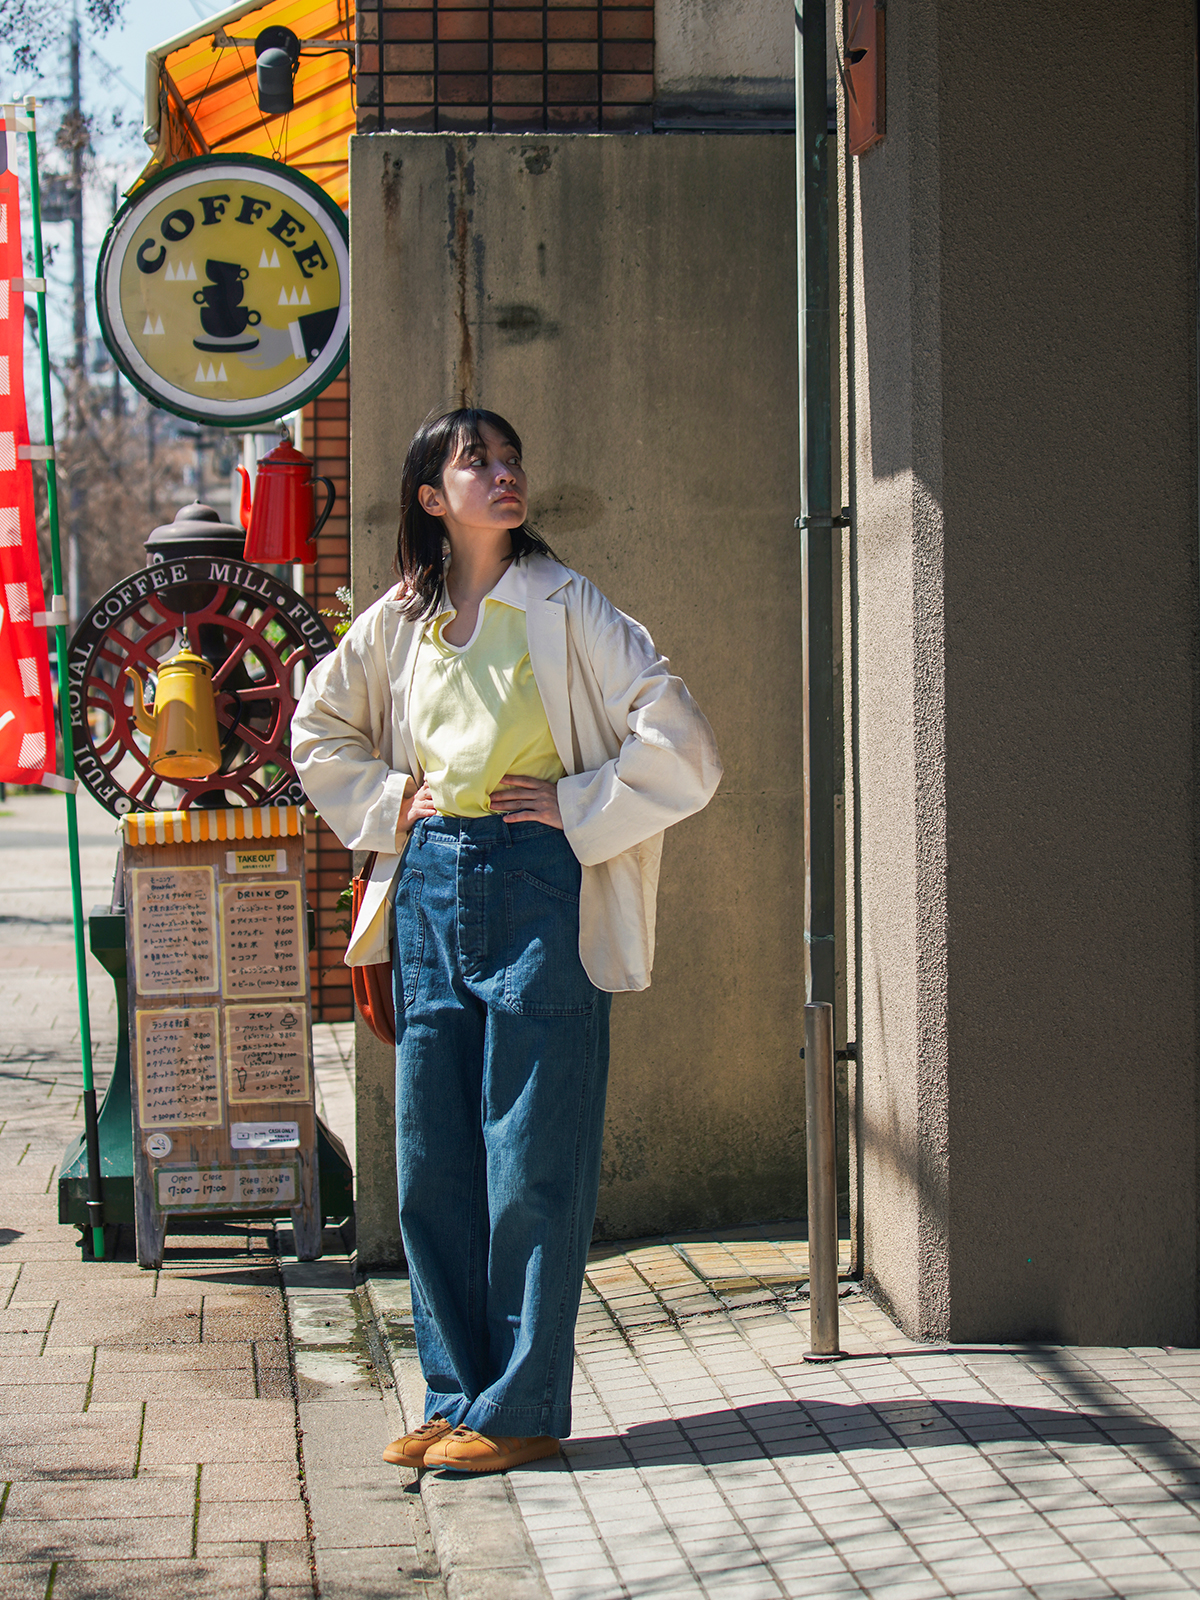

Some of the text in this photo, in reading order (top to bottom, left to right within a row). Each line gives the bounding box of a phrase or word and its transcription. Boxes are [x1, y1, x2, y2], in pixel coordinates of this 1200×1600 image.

[136, 194, 328, 278] COFFEE
[208, 563, 272, 598] MILL
[92, 564, 188, 629] COFFEE
[69, 642, 94, 726] ROYAL
[73, 744, 119, 802] FUJI
[237, 854, 275, 863] TAKE OUT
[237, 890, 271, 900] DRINK
[276, 904, 295, 912] ¥500
[276, 916, 294, 924] ¥500
[275, 928, 294, 936] ¥600
[274, 940, 293, 949] ¥550
[278, 965, 297, 973] ¥550
[248, 1012, 273, 1020] スイーツ
[171, 1173, 222, 1184] Open Close
[168, 1186, 192, 1197] 7:00
[203, 1185, 226, 1195] 17:00
